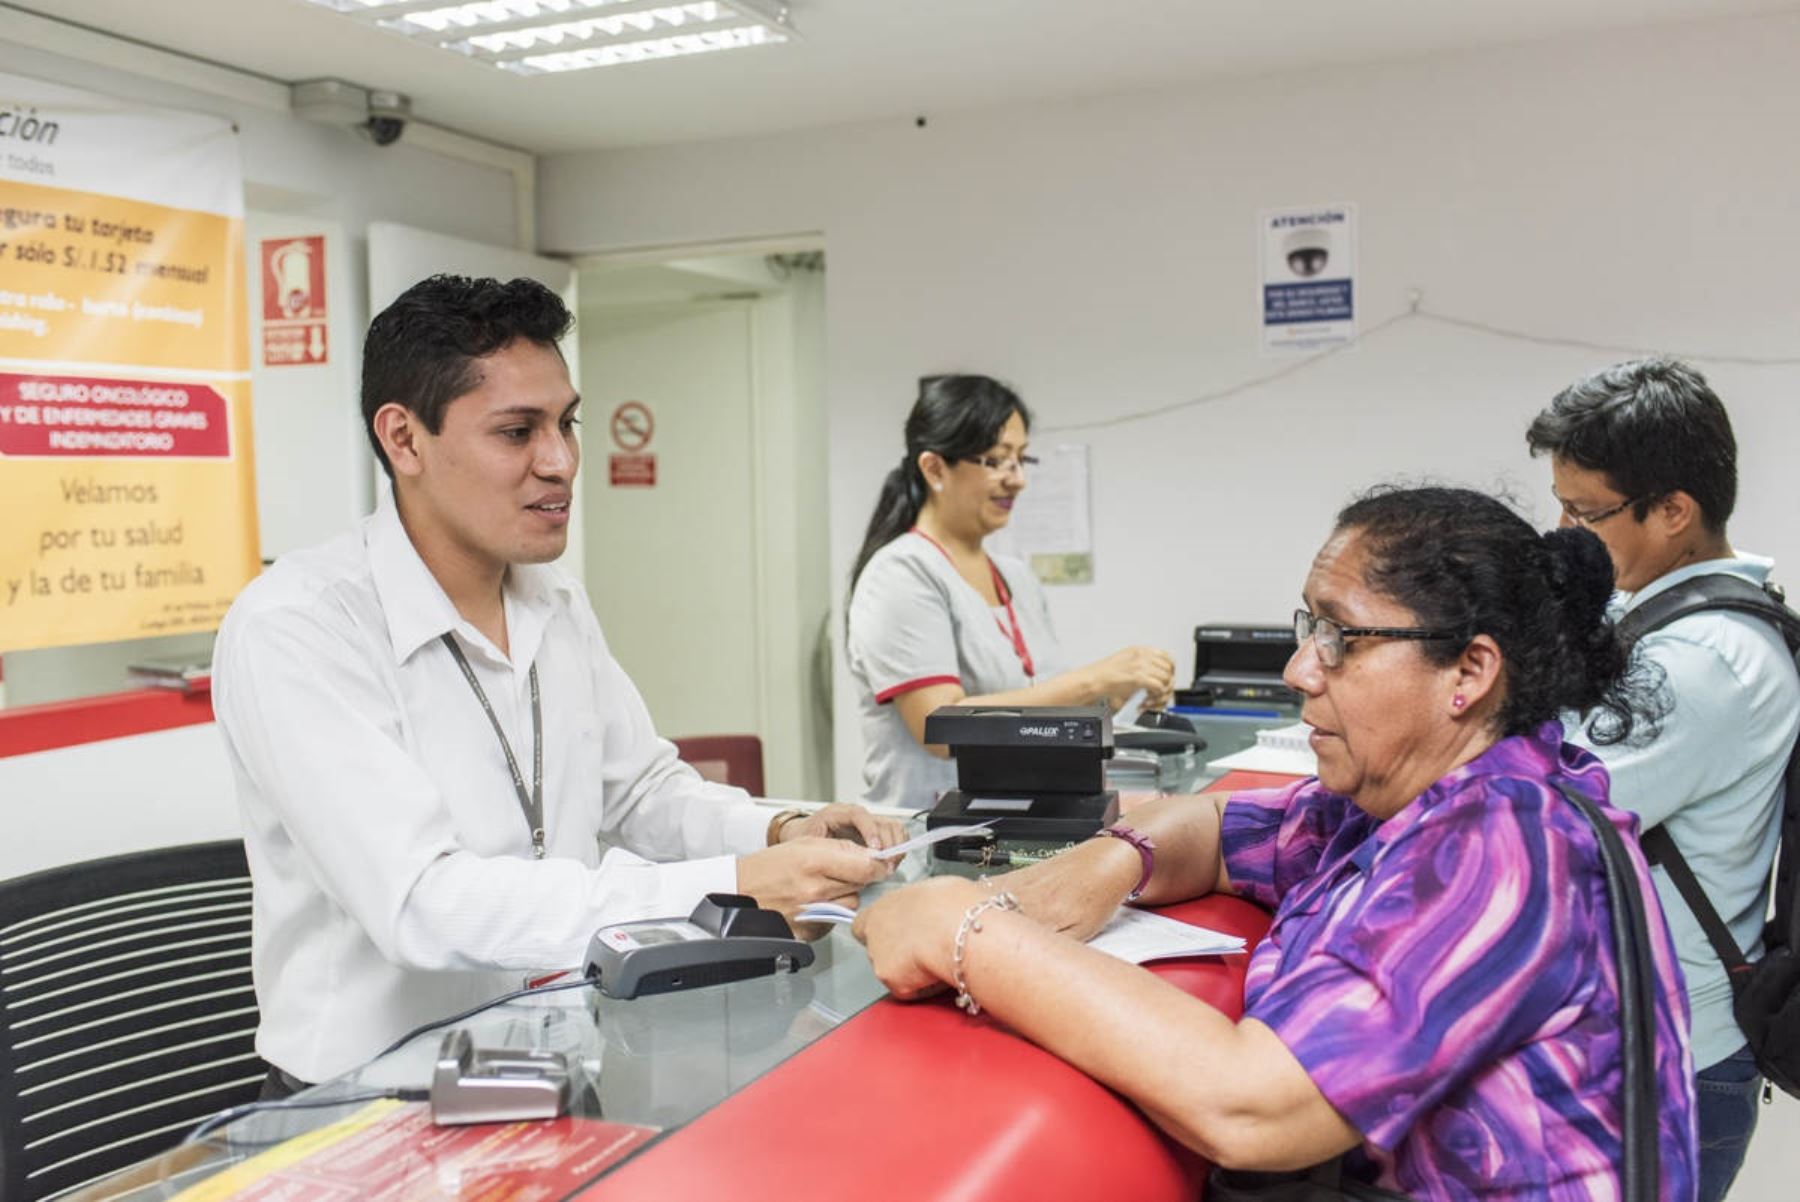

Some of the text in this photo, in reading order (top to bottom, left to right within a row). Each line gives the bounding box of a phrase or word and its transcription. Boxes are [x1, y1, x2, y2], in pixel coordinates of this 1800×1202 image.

[64, 213, 85, 234] tu
[91, 217, 154, 246] tarjeta
[1271, 210, 1345, 229] ATENCIÓN
[18, 381, 189, 408] SEGURO ONCOLÓGICO
[0, 405, 208, 431] Y DE ENFERMEDADES GRAVES
[60, 477, 158, 505] Velamos
[39, 522, 184, 557] por tu salud
[8, 562, 206, 605] y la de tu familia
